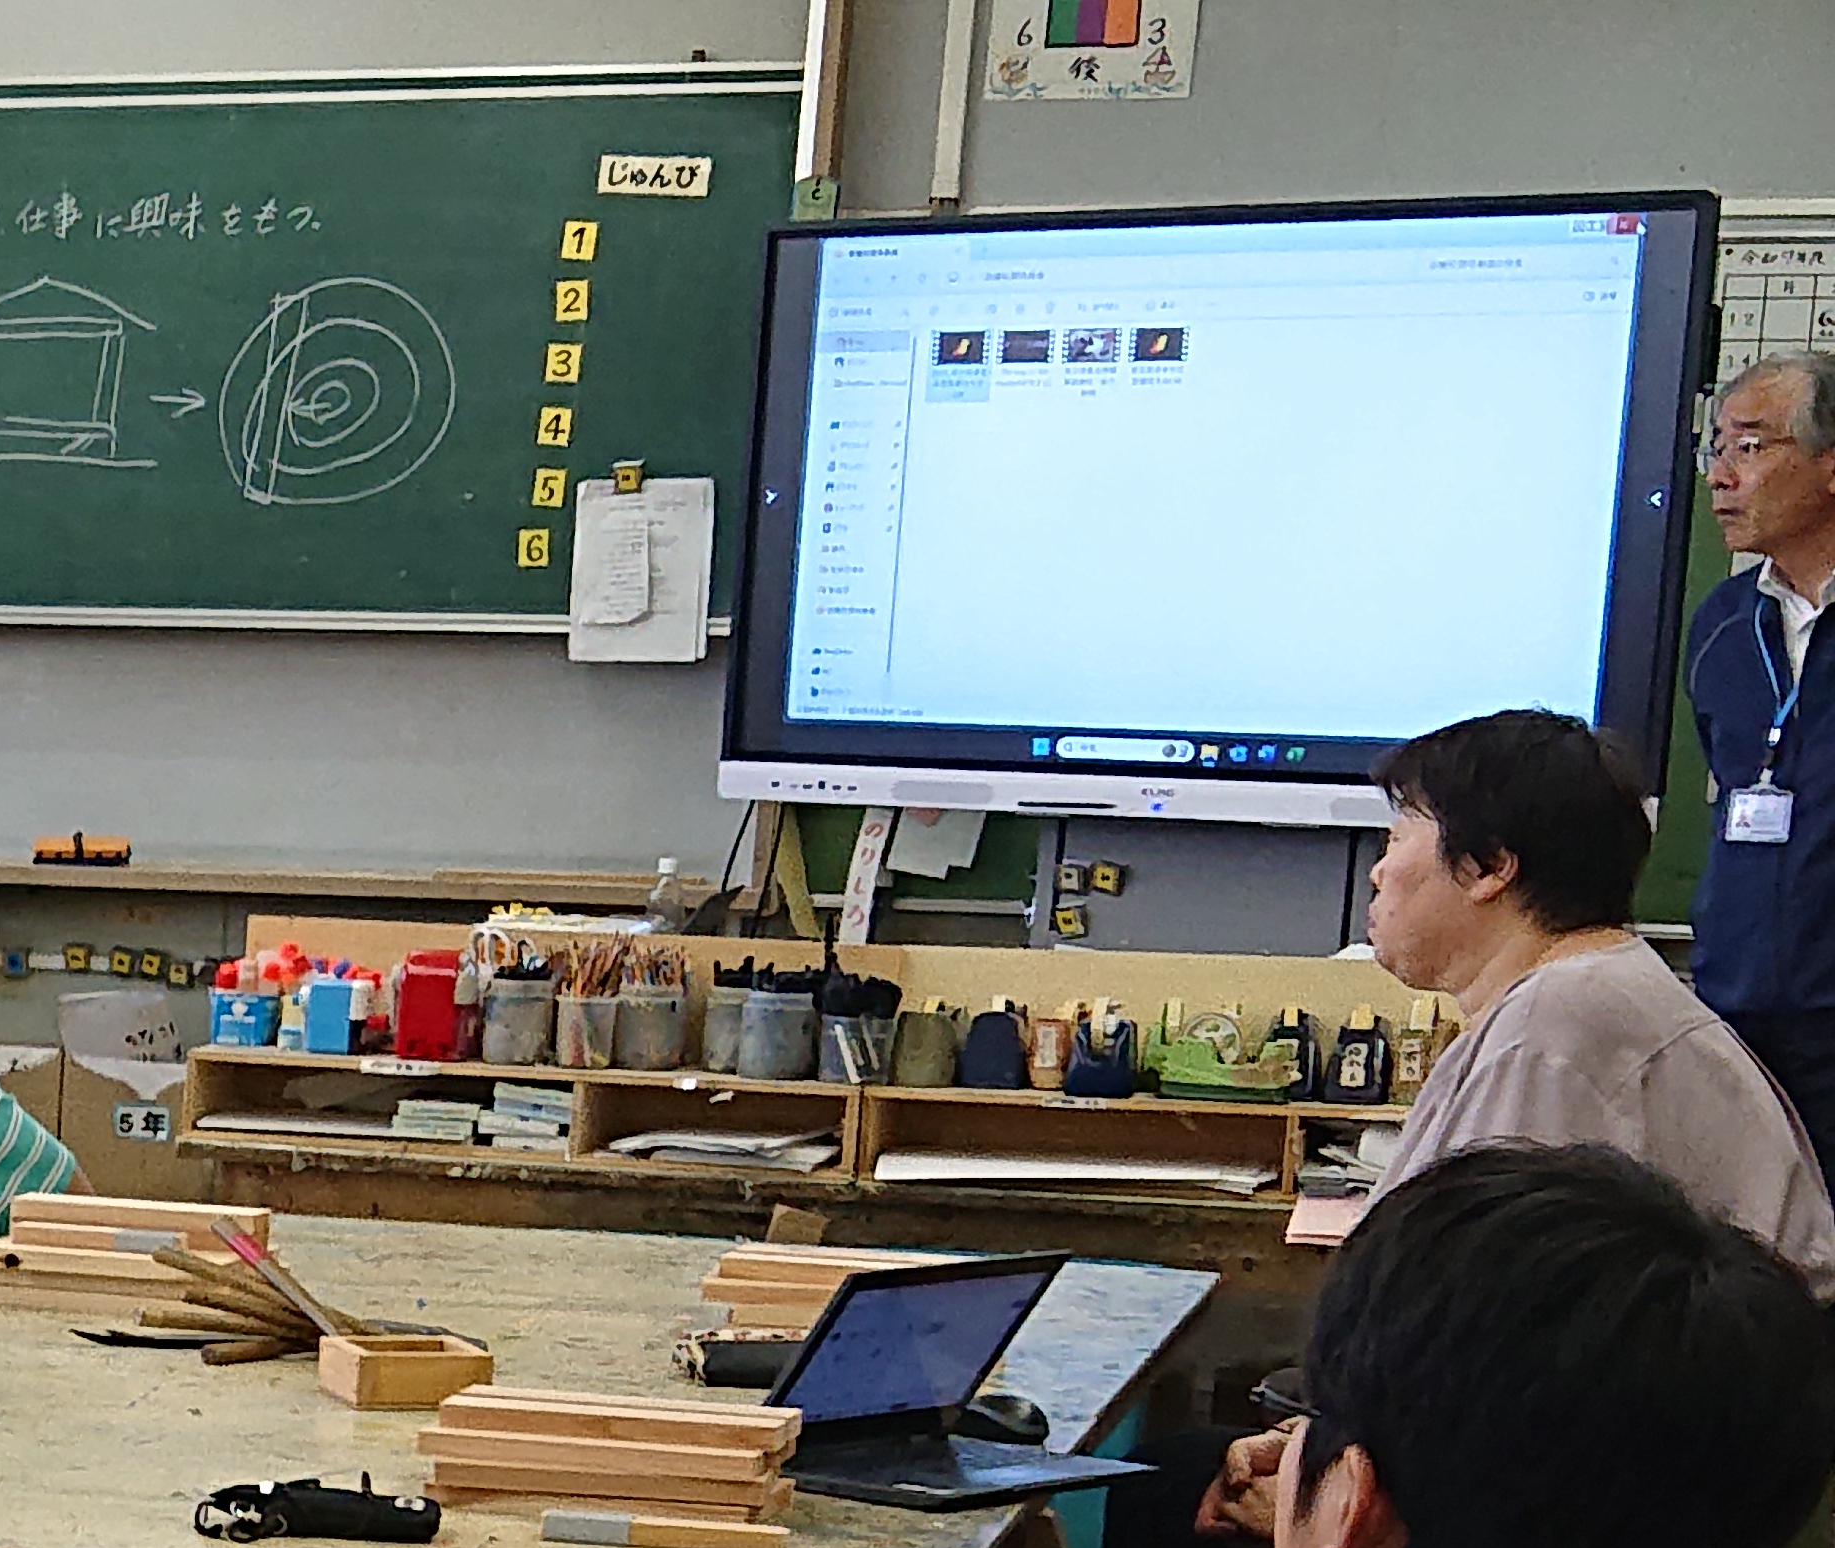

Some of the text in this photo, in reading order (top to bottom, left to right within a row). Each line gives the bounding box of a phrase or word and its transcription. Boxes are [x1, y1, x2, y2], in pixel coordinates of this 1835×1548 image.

[1017, 18, 1166, 46] 6 3
[607, 161, 703, 188] じゅんび
[571, 227, 587, 253] 1
[563, 288, 581, 314] 2
[552, 350, 572, 377] 3
[544, 413, 565, 440] 4
[541, 477, 557, 502] 5
[525, 535, 543, 563] 6
[119, 1111, 166, 1136] 5年
